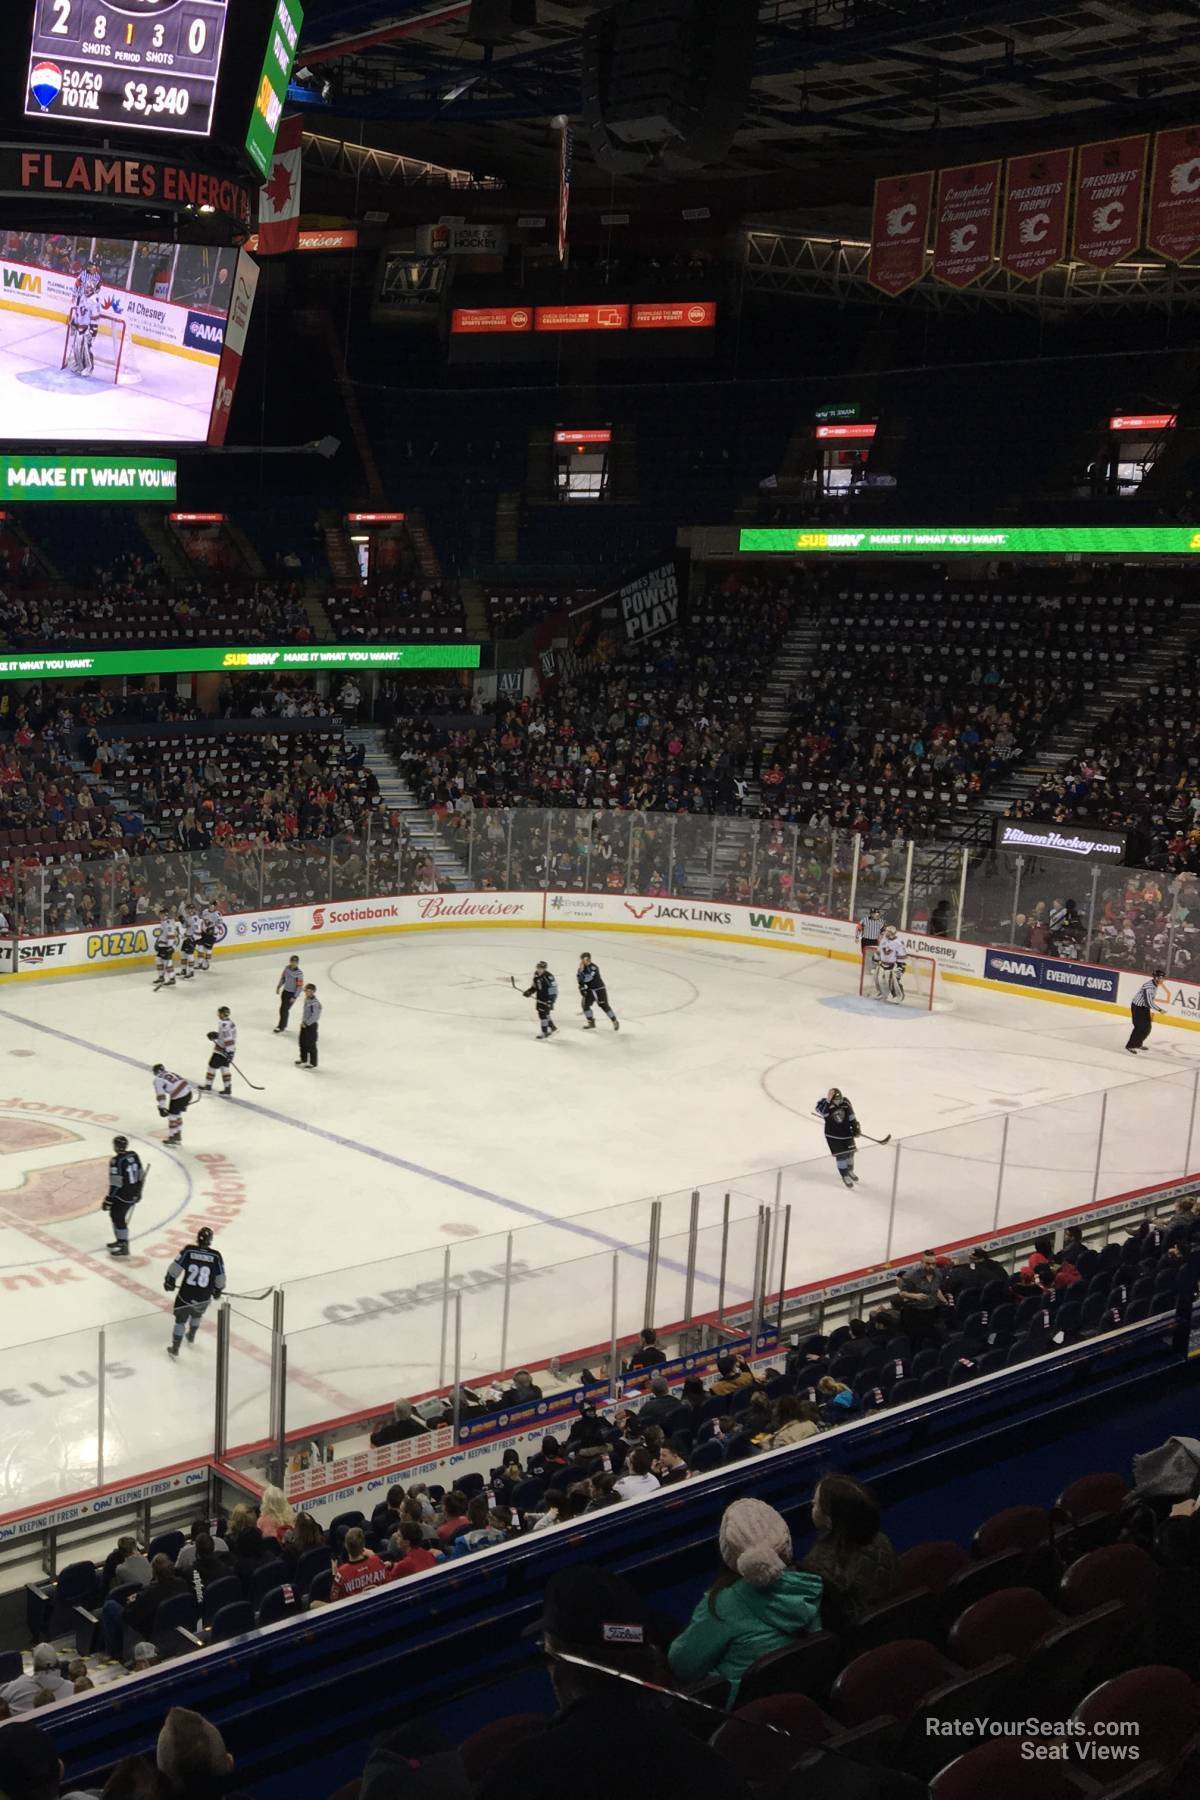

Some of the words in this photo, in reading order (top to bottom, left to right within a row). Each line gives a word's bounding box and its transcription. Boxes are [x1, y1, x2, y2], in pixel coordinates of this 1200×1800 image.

[51, 0, 71, 34] 2
[93, 15, 107, 39] 8
[152, 24, 165, 47] 3
[188, 18, 206, 54] 0
[82, 42, 111, 57] SHOTS
[114, 51, 140, 64] PERIOD
[145, 50, 174, 65] SHOTS
[62, 69, 103, 90] 50/50
[62, 87, 100, 110] TOTAL
[123, 81, 190, 116] $3,340
[21, 153, 156, 197] FLAMES
[164, 168, 239, 211] ENERGY
[945, 182, 994, 202] Campbell
[1091, 184, 1128, 200] TROPHY
[1018, 198, 1052, 213] TROPHY
[454, 238, 497, 248] HOCKEY
[3, 267, 42, 294] WM
[138, 303, 166, 323] Chesney
[7, 467, 66, 487] MAKE
[70, 467, 89, 487] IT
[90, 468, 135, 487] WHAT
[138, 469, 160, 487] YOU
[798, 533, 866, 547] SUBWAY
[870, 535, 901, 545] MAKE
[902, 535, 914, 544] IT
[915, 534, 948, 544] WHAT
[948, 534, 970, 544] YOU
[621, 575, 678, 619] POWER
[625, 597, 679, 640] PLAY
[9, 662, 18, 671] IT
[19, 661, 45, 671] WHAT
[45, 660, 64, 669] YOU
[223, 652, 280, 666] SUBWAY
[284, 653, 309, 662] MAKE
[310, 653, 319, 661] IT
[320, 653, 347, 661] WHAT
[348, 652, 368, 661] YOU
[1002, 828, 1121, 854] HitmenHockey.com
[329, 904, 398, 923] Scotiabank
[417, 896, 524, 918] Budweiser
[654, 905, 690, 921] JACK
[691, 908, 732, 925] LINK'S
[251, 920, 291, 935] Synergy
[749, 912, 796, 932] WM
[87, 929, 148, 958] PIZZA
[918, 942, 957, 958] Chesney
[1000, 958, 1037, 978] AMA
[1046, 969, 1086, 987] EVERYDAY
[1086, 974, 1113, 992] SAVES
[187, 1264, 212, 1289] 28
[344, 1569, 385, 1592] WIDEMAN
